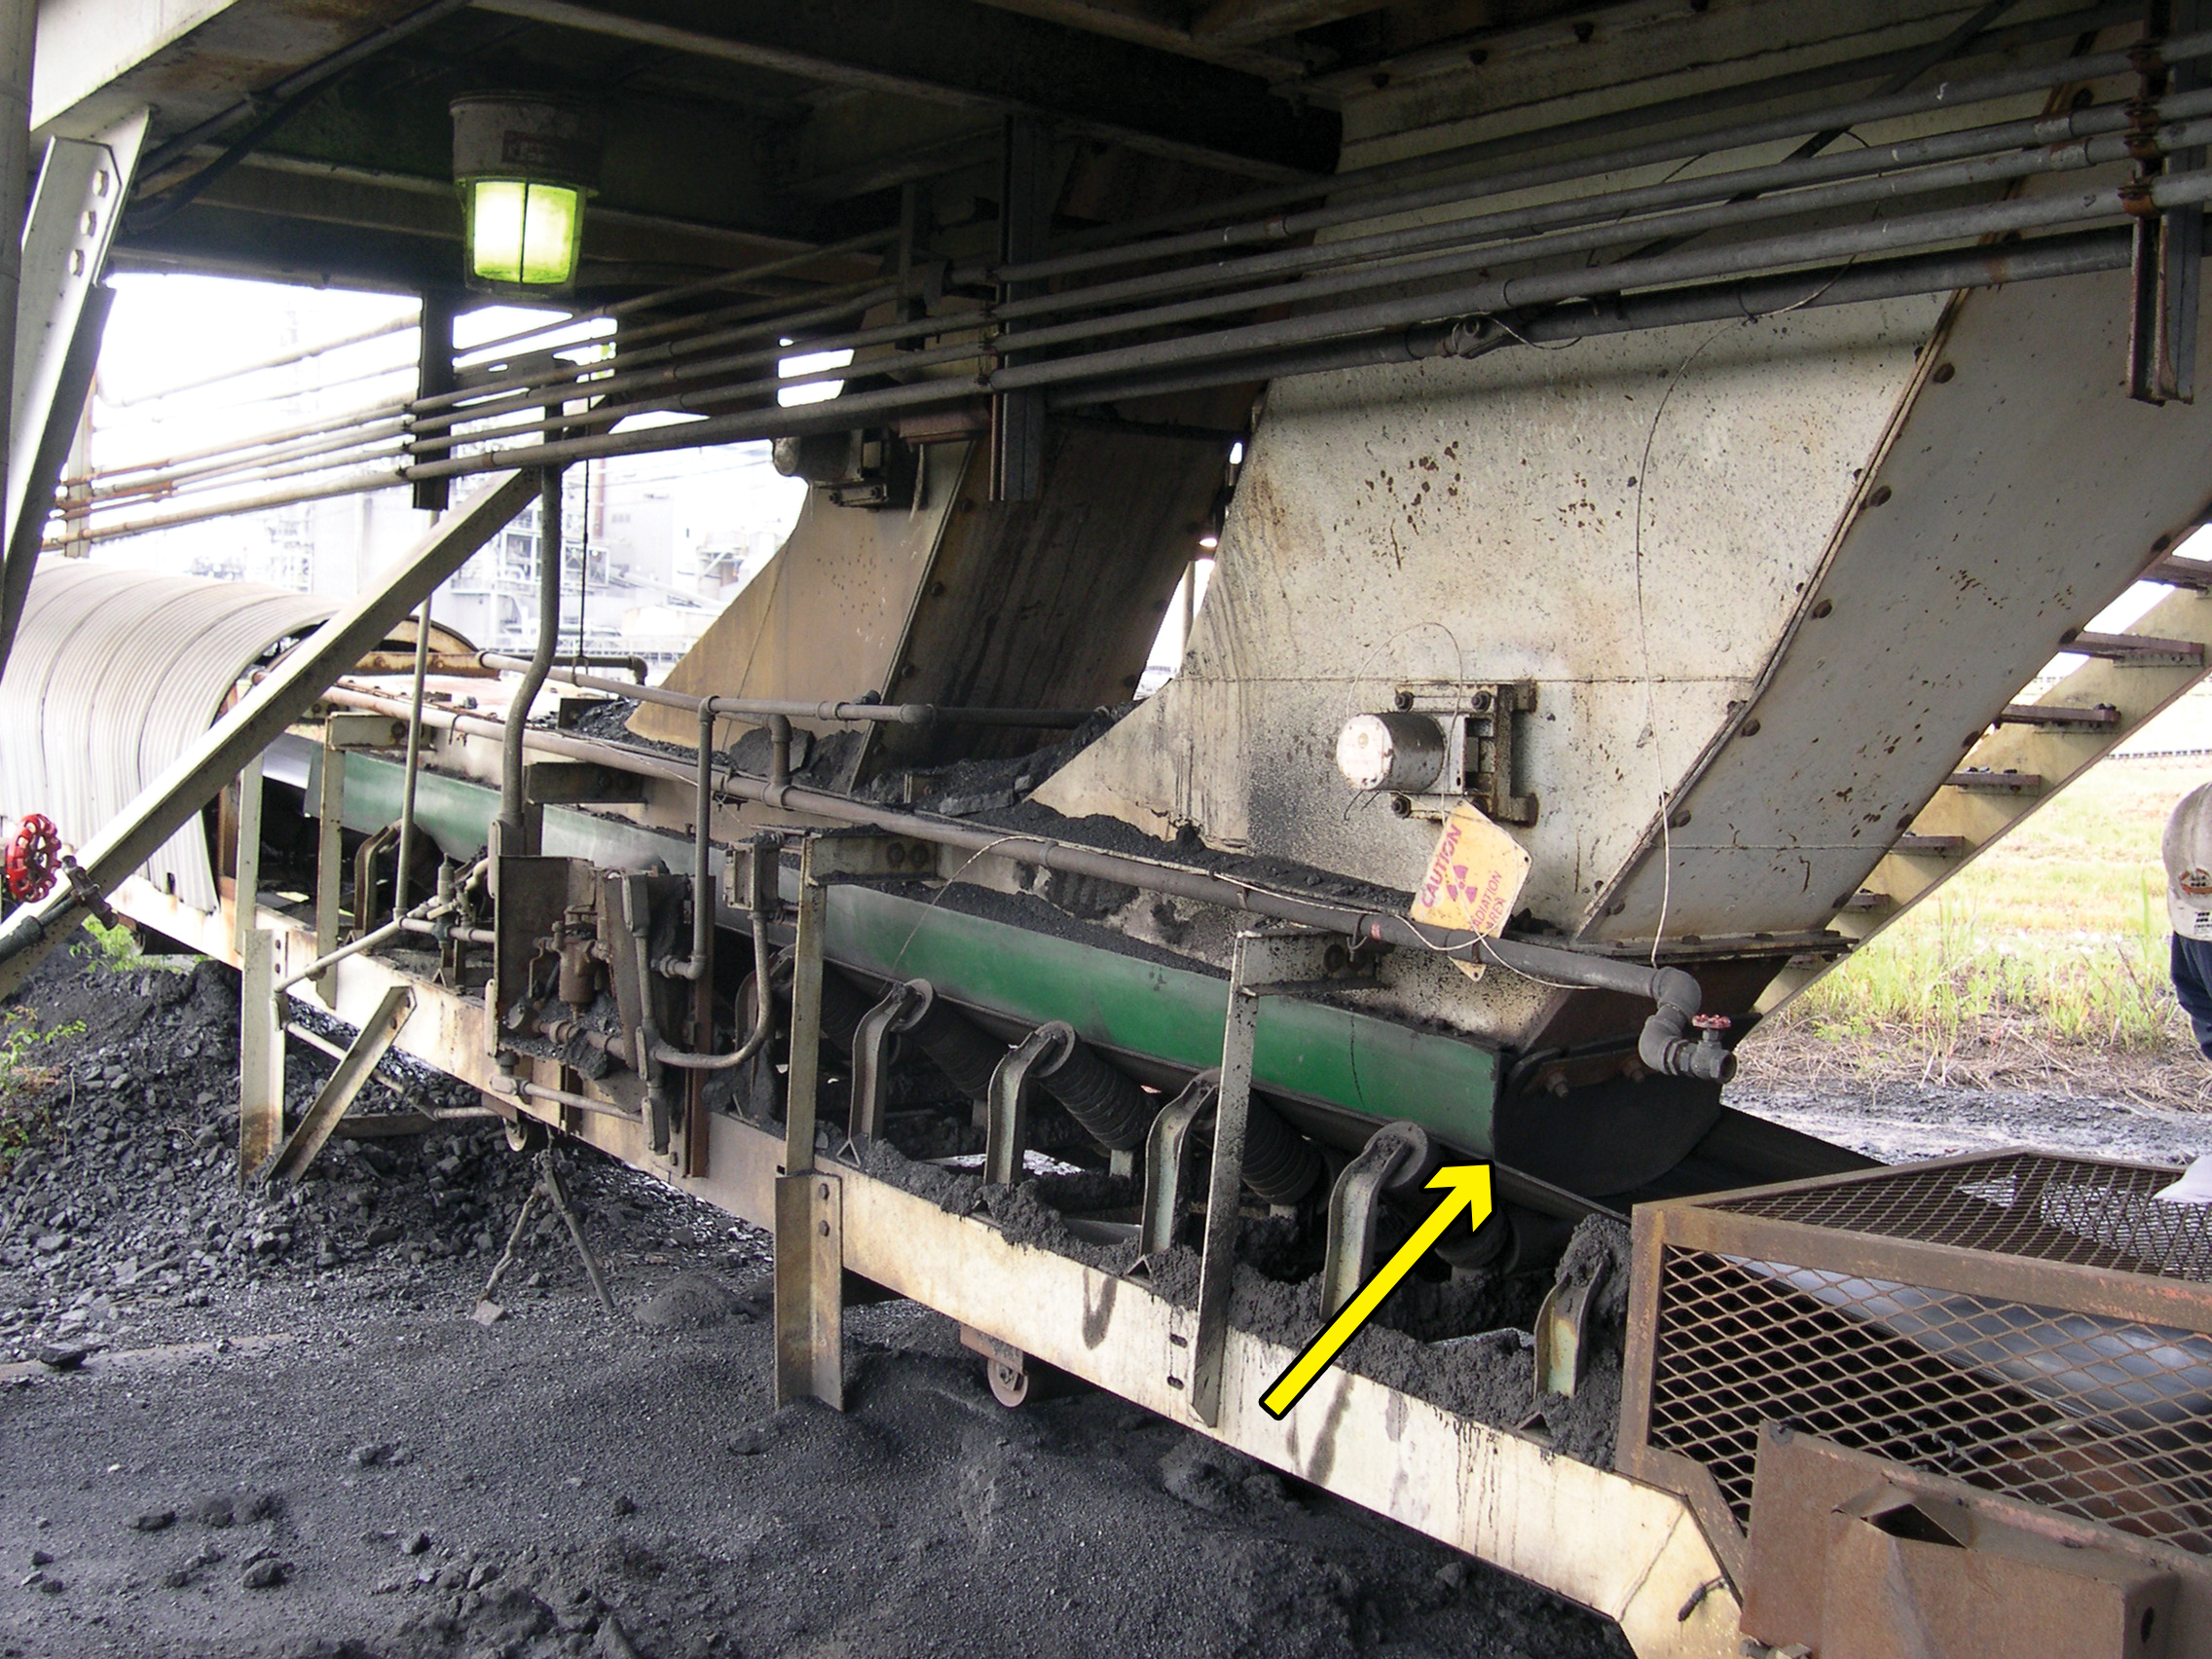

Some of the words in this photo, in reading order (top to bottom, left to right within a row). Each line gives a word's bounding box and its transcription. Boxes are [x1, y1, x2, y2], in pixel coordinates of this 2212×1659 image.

[1420, 824, 1462, 908] CAUTION
[1470, 869, 1503, 932] ADIATION
[1486, 897, 1507, 931] AREA
